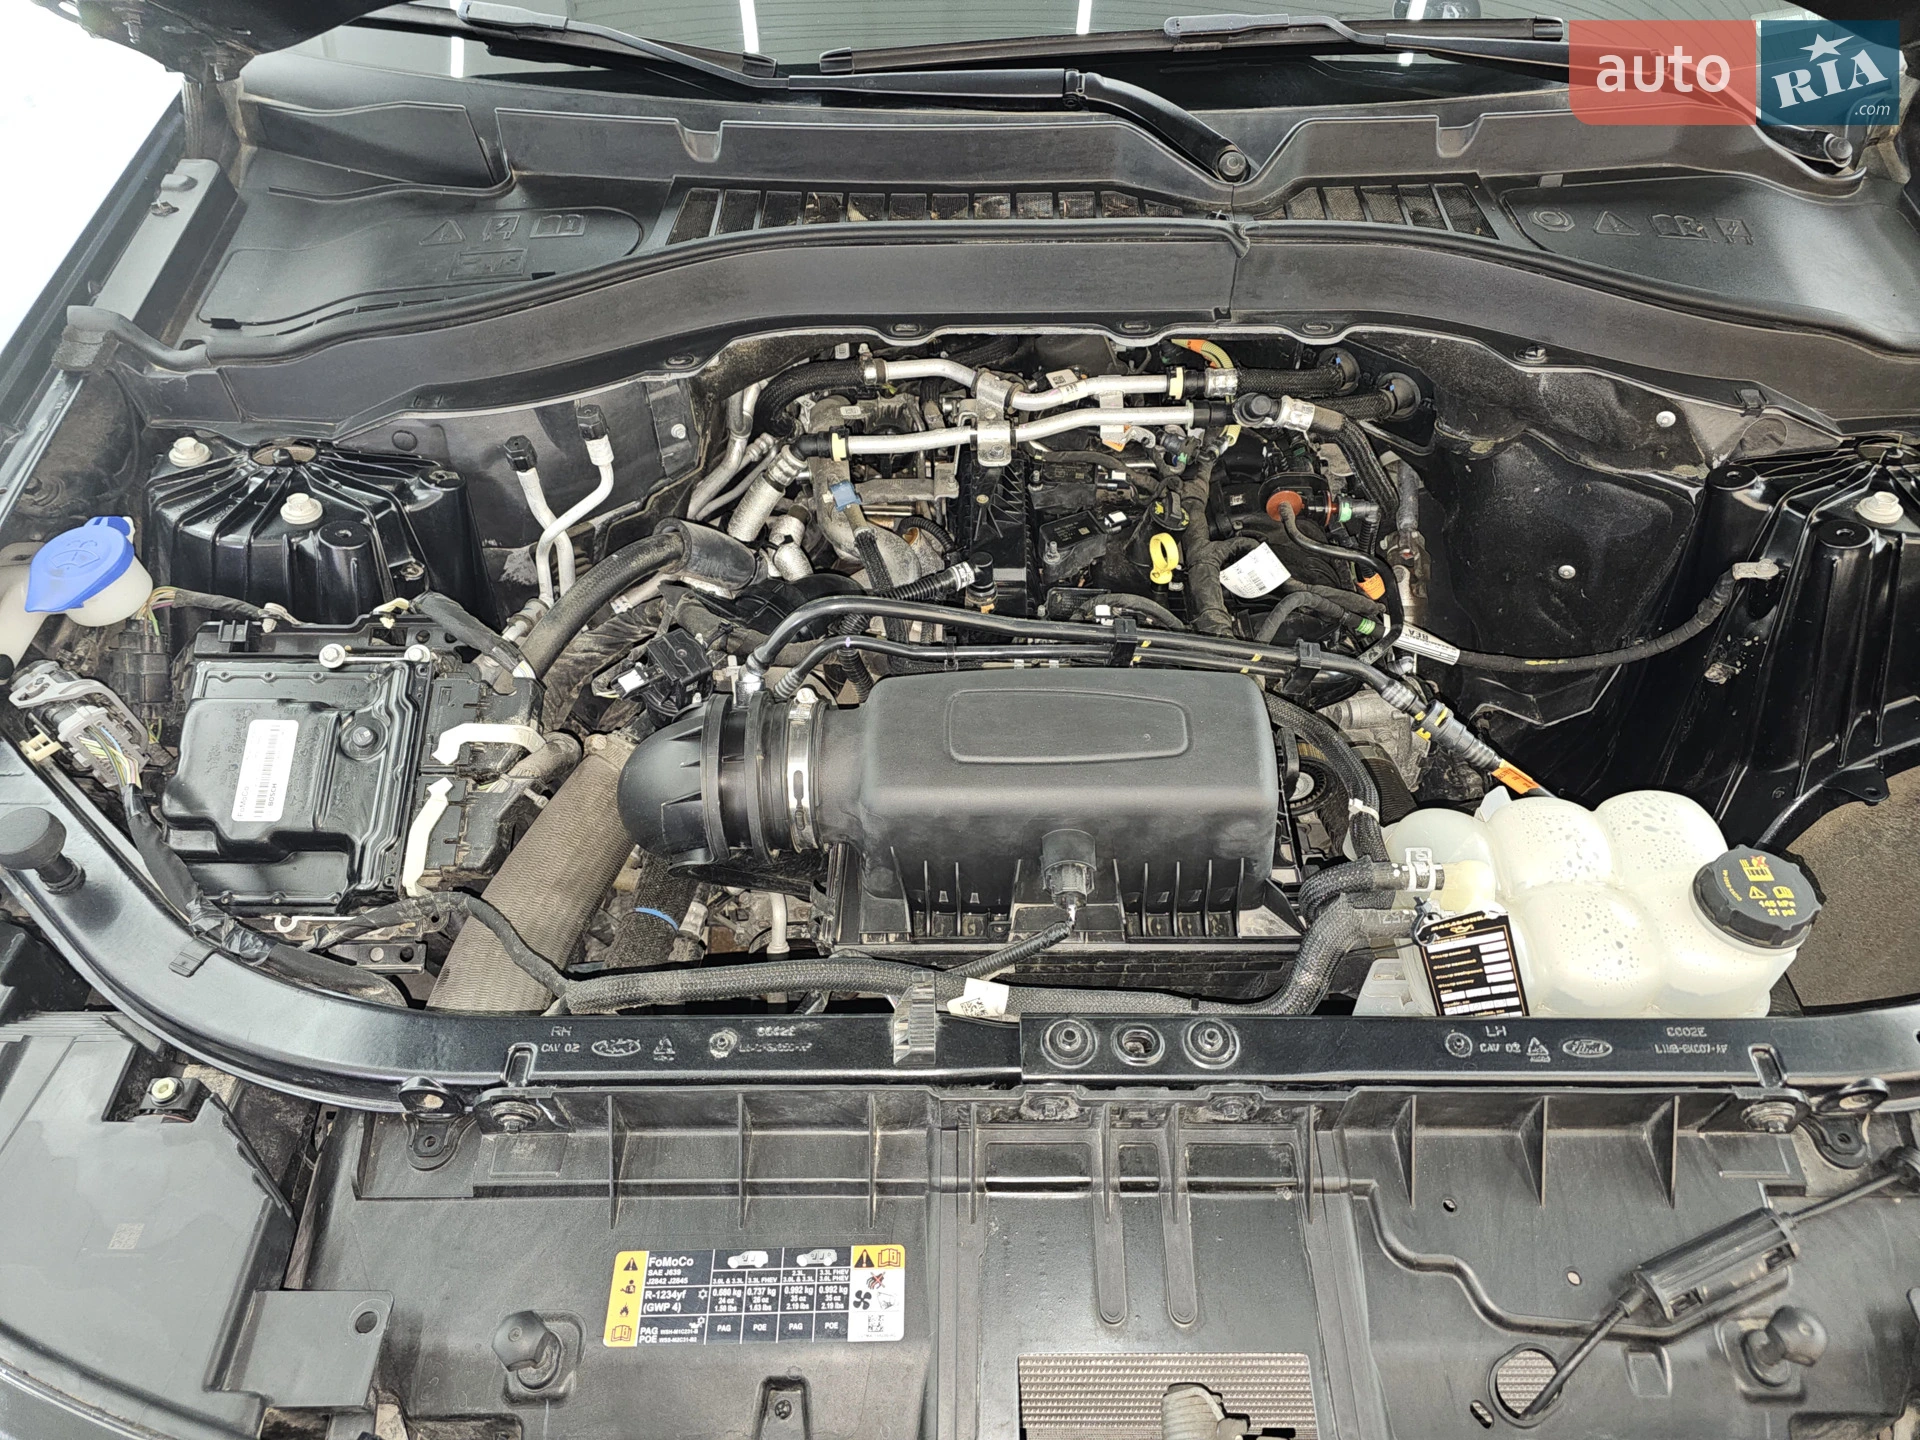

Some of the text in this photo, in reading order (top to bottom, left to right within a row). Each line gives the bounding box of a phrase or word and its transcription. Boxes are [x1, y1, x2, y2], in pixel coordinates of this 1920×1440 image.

[268, 783, 277, 806] BOSCH
[237, 786, 250, 817] FoMoCo
[1781, 908, 1796, 917] psi
[551, 1026, 572, 1037] RH
[1485, 1025, 1507, 1037] LH
[564, 1043, 580, 1053] 02
[1480, 1043, 1500, 1053] CAV
[1570, 1039, 1606, 1056] Ford
[648, 1256, 694, 1267] FoMoCo
[712, 1288, 741, 1298] 0.680 kg
[747, 1287, 776, 1297] 0.737 kg
[784, 1286, 814, 1295] 0.992 kg
[819, 1285, 848, 1295] 0.992 kg
[645, 1290, 686, 1301] R-1234yf
[643, 1302, 681, 1314] (GWP 4)
[639, 1335, 657, 1343] POE
